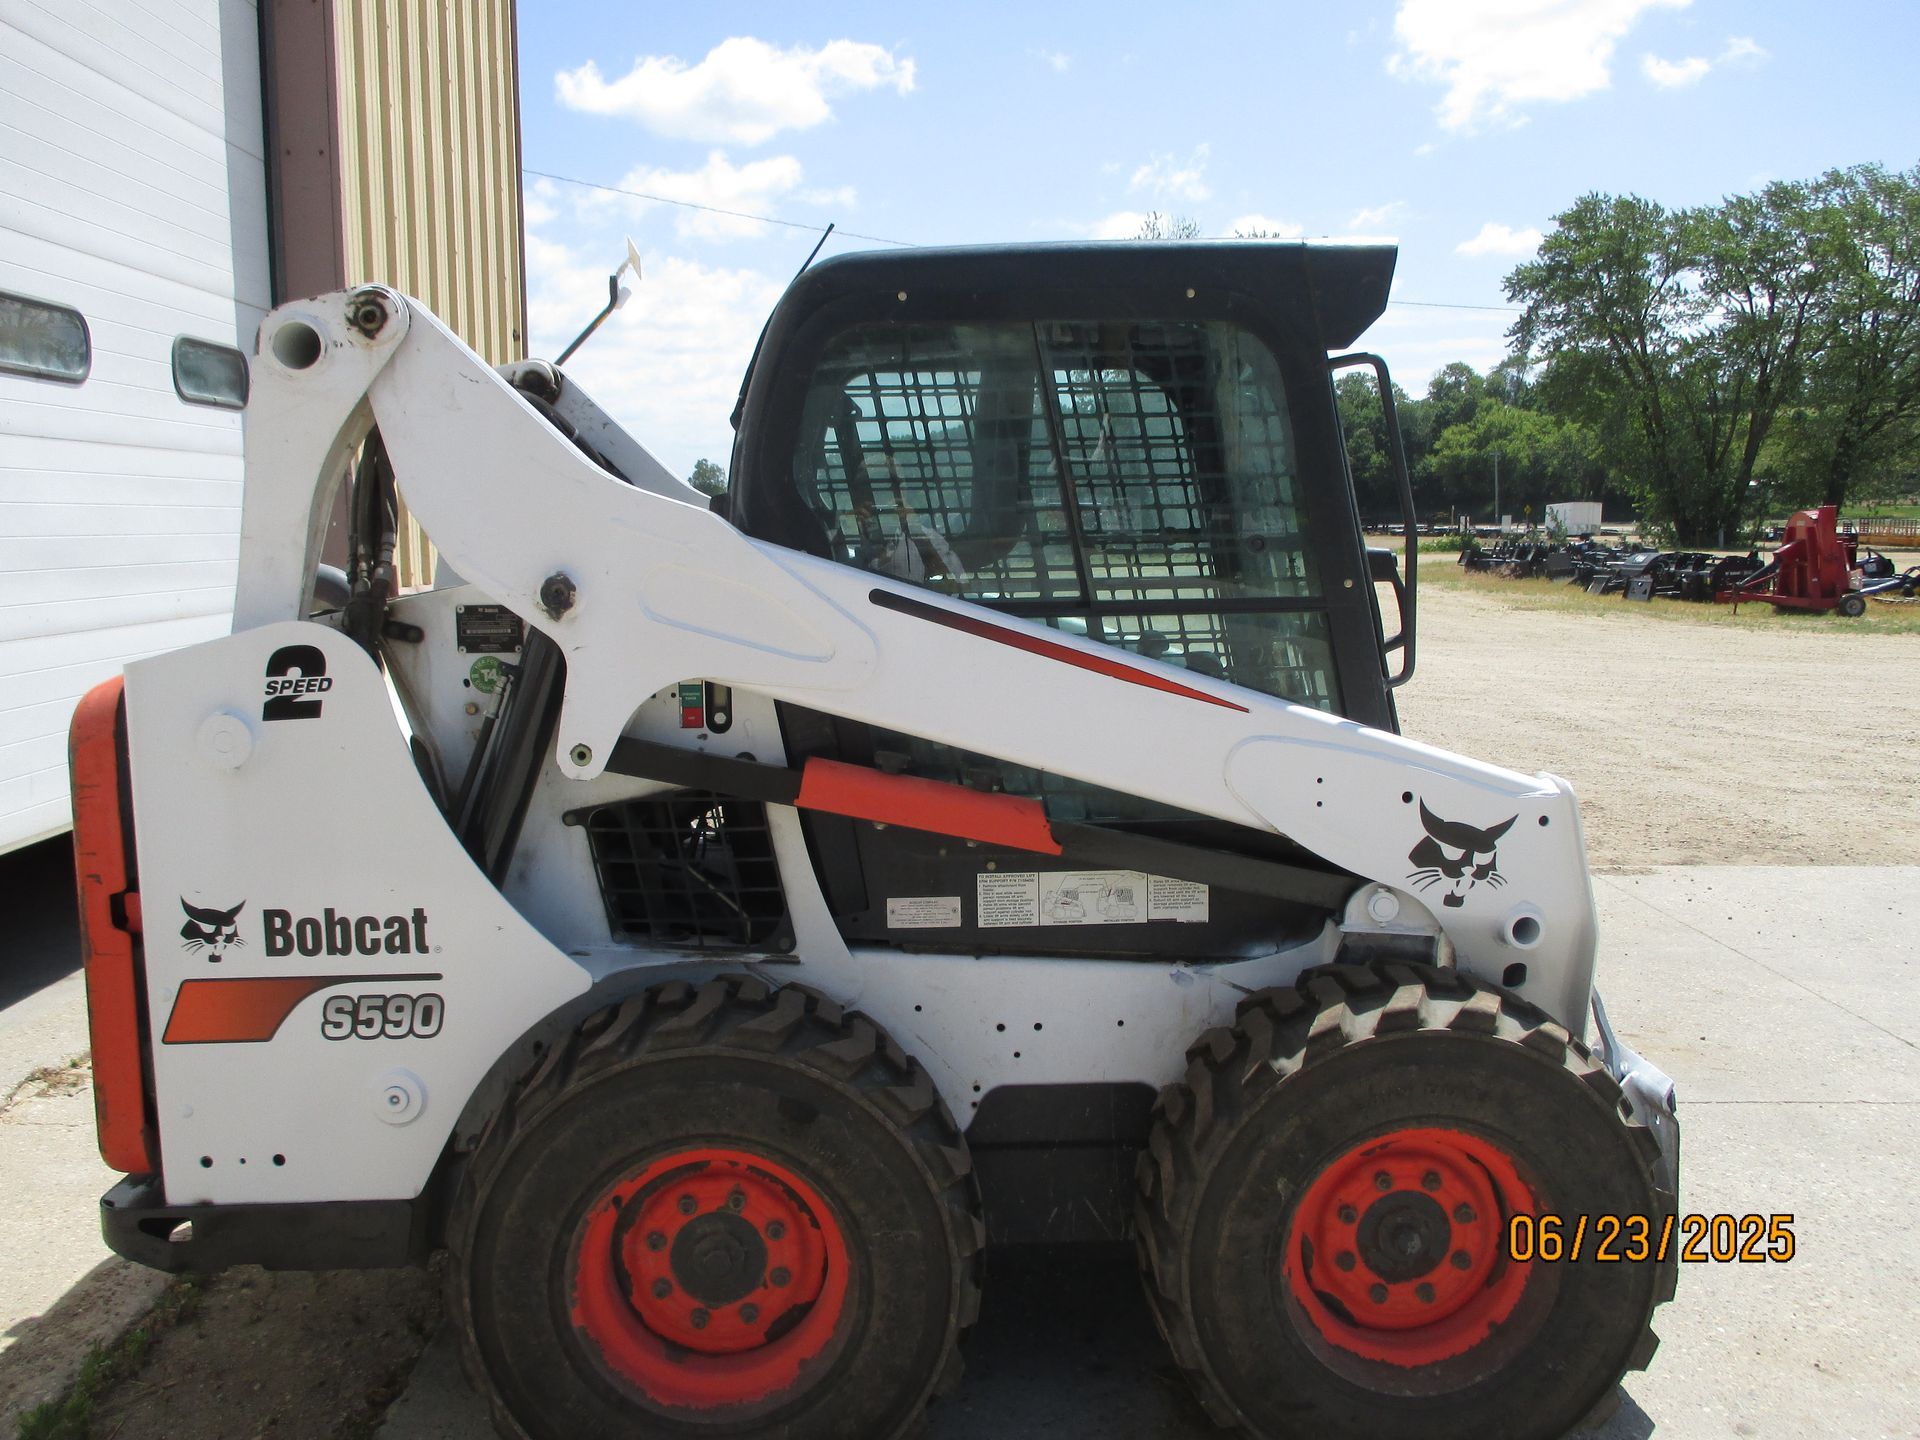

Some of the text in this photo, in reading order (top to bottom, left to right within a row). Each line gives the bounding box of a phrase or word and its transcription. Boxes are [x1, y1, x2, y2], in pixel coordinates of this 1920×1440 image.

[262, 645, 333, 721] 2 SPEED
[263, 908, 430, 957] Bobcat
[321, 993, 445, 1041] S590
